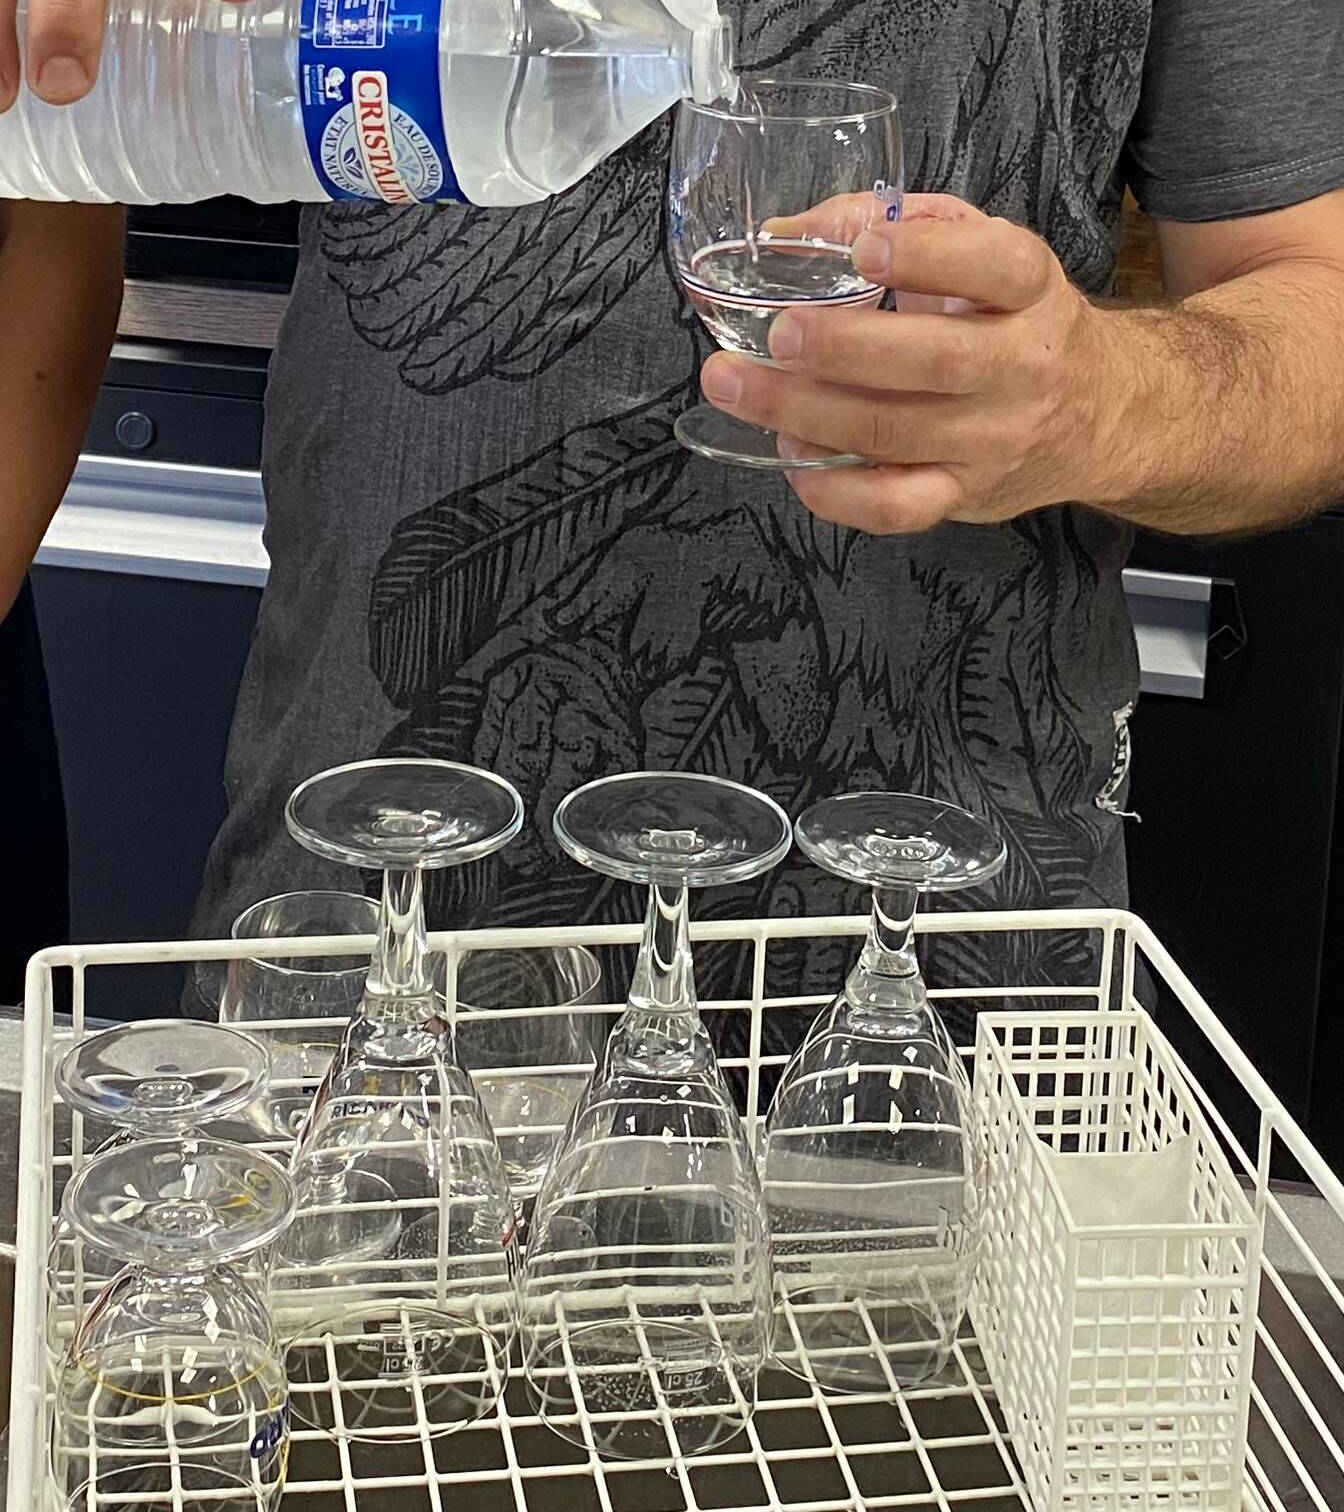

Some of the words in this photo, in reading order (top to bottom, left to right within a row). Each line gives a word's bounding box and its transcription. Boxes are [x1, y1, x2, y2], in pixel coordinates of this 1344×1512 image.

[325, 116, 348, 149] ETAT
[393, 114, 424, 142] EAU
[418, 144, 436, 164] DE
